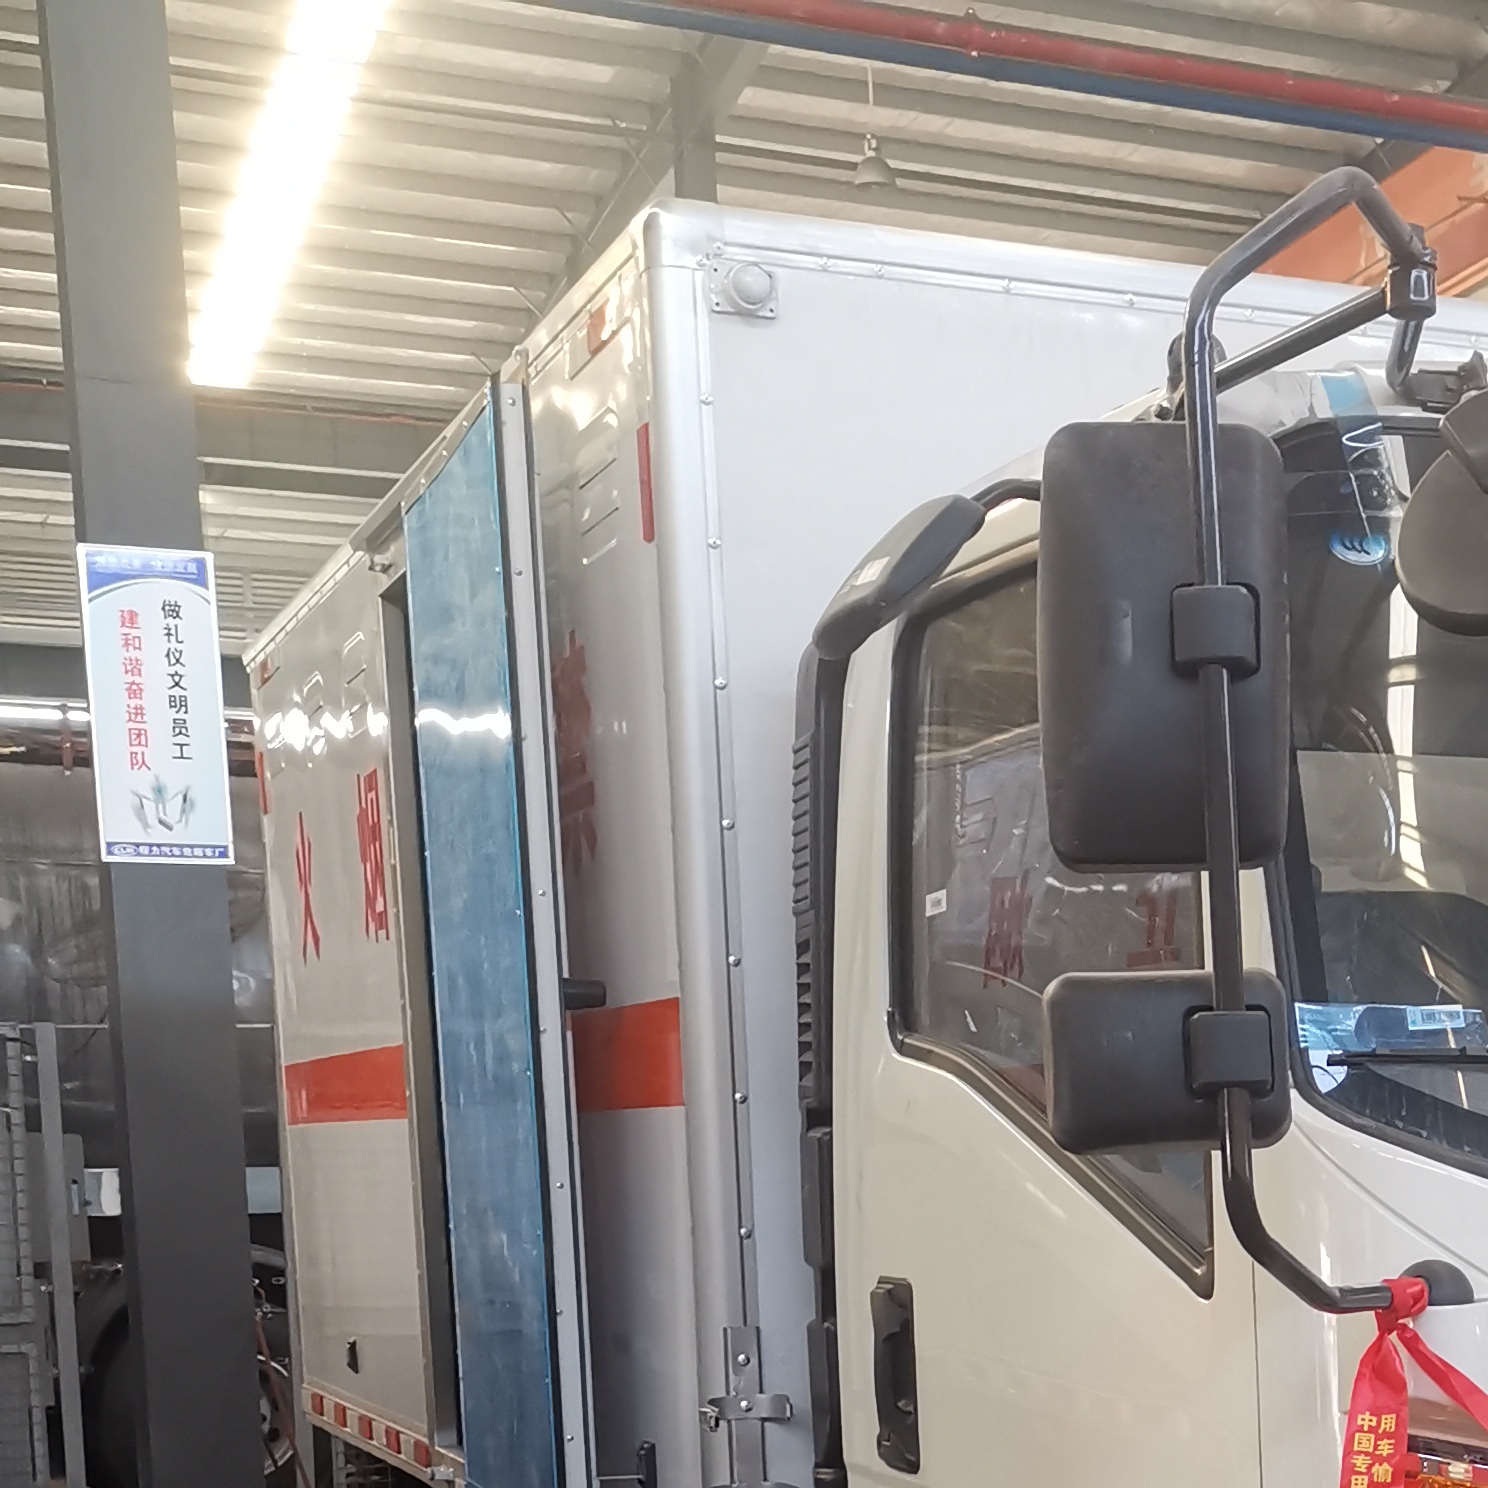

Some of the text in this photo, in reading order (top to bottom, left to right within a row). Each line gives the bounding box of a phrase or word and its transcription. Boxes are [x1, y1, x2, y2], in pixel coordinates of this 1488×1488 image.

[118, 609, 151, 772] 建和谐奋进团队
[161, 599, 193, 761] 做礼仪文明员工
